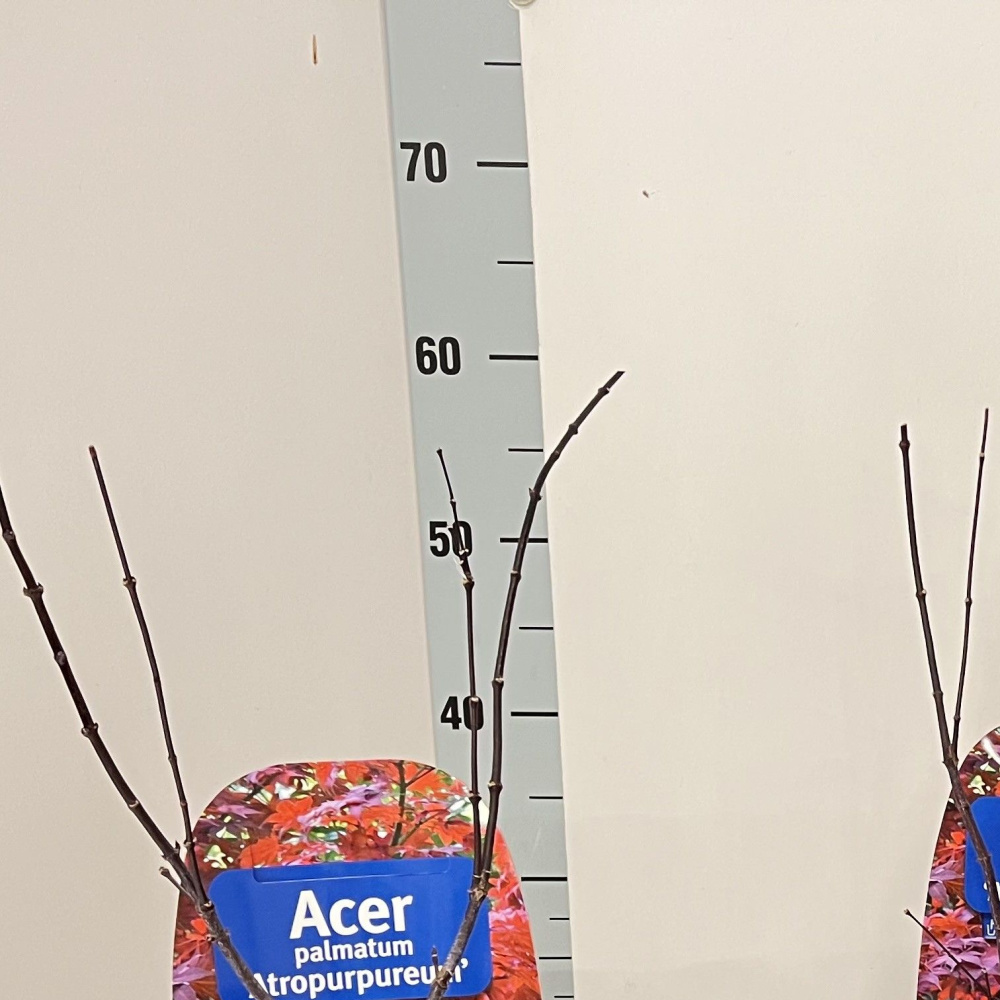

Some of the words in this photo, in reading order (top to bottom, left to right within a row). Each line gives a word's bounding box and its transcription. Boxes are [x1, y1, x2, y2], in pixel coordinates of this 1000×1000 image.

[400, 141, 447, 183] 70
[415, 335, 461, 375] 60
[429, 520, 473, 557] 50
[440, 695, 484, 731] 40
[289, 889, 414, 940] Acer
[294, 938, 414, 969] palmatum
